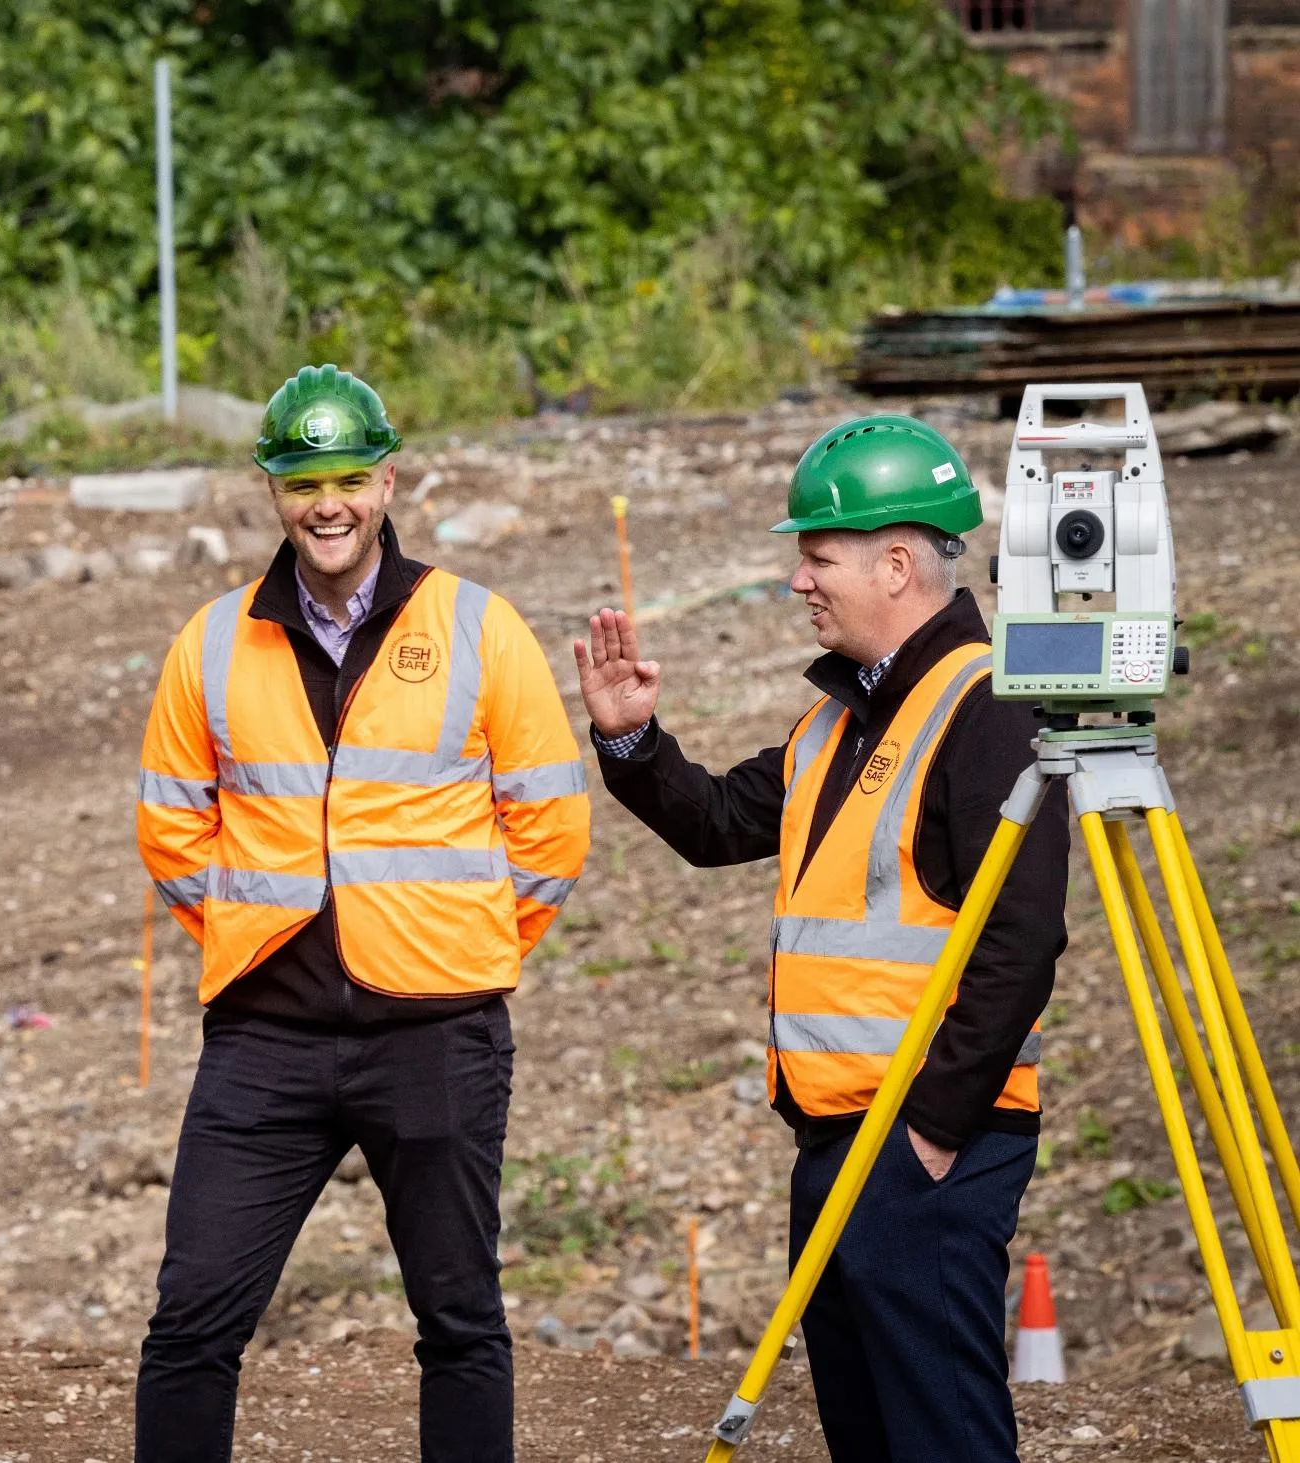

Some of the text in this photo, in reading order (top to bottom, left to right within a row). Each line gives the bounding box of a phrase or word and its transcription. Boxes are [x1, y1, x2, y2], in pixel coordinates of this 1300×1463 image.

[307, 418, 332, 430] ESH
[307, 429, 332, 438] SAFE
[399, 646, 431, 661] ESH
[397, 659, 429, 672] SAFE
